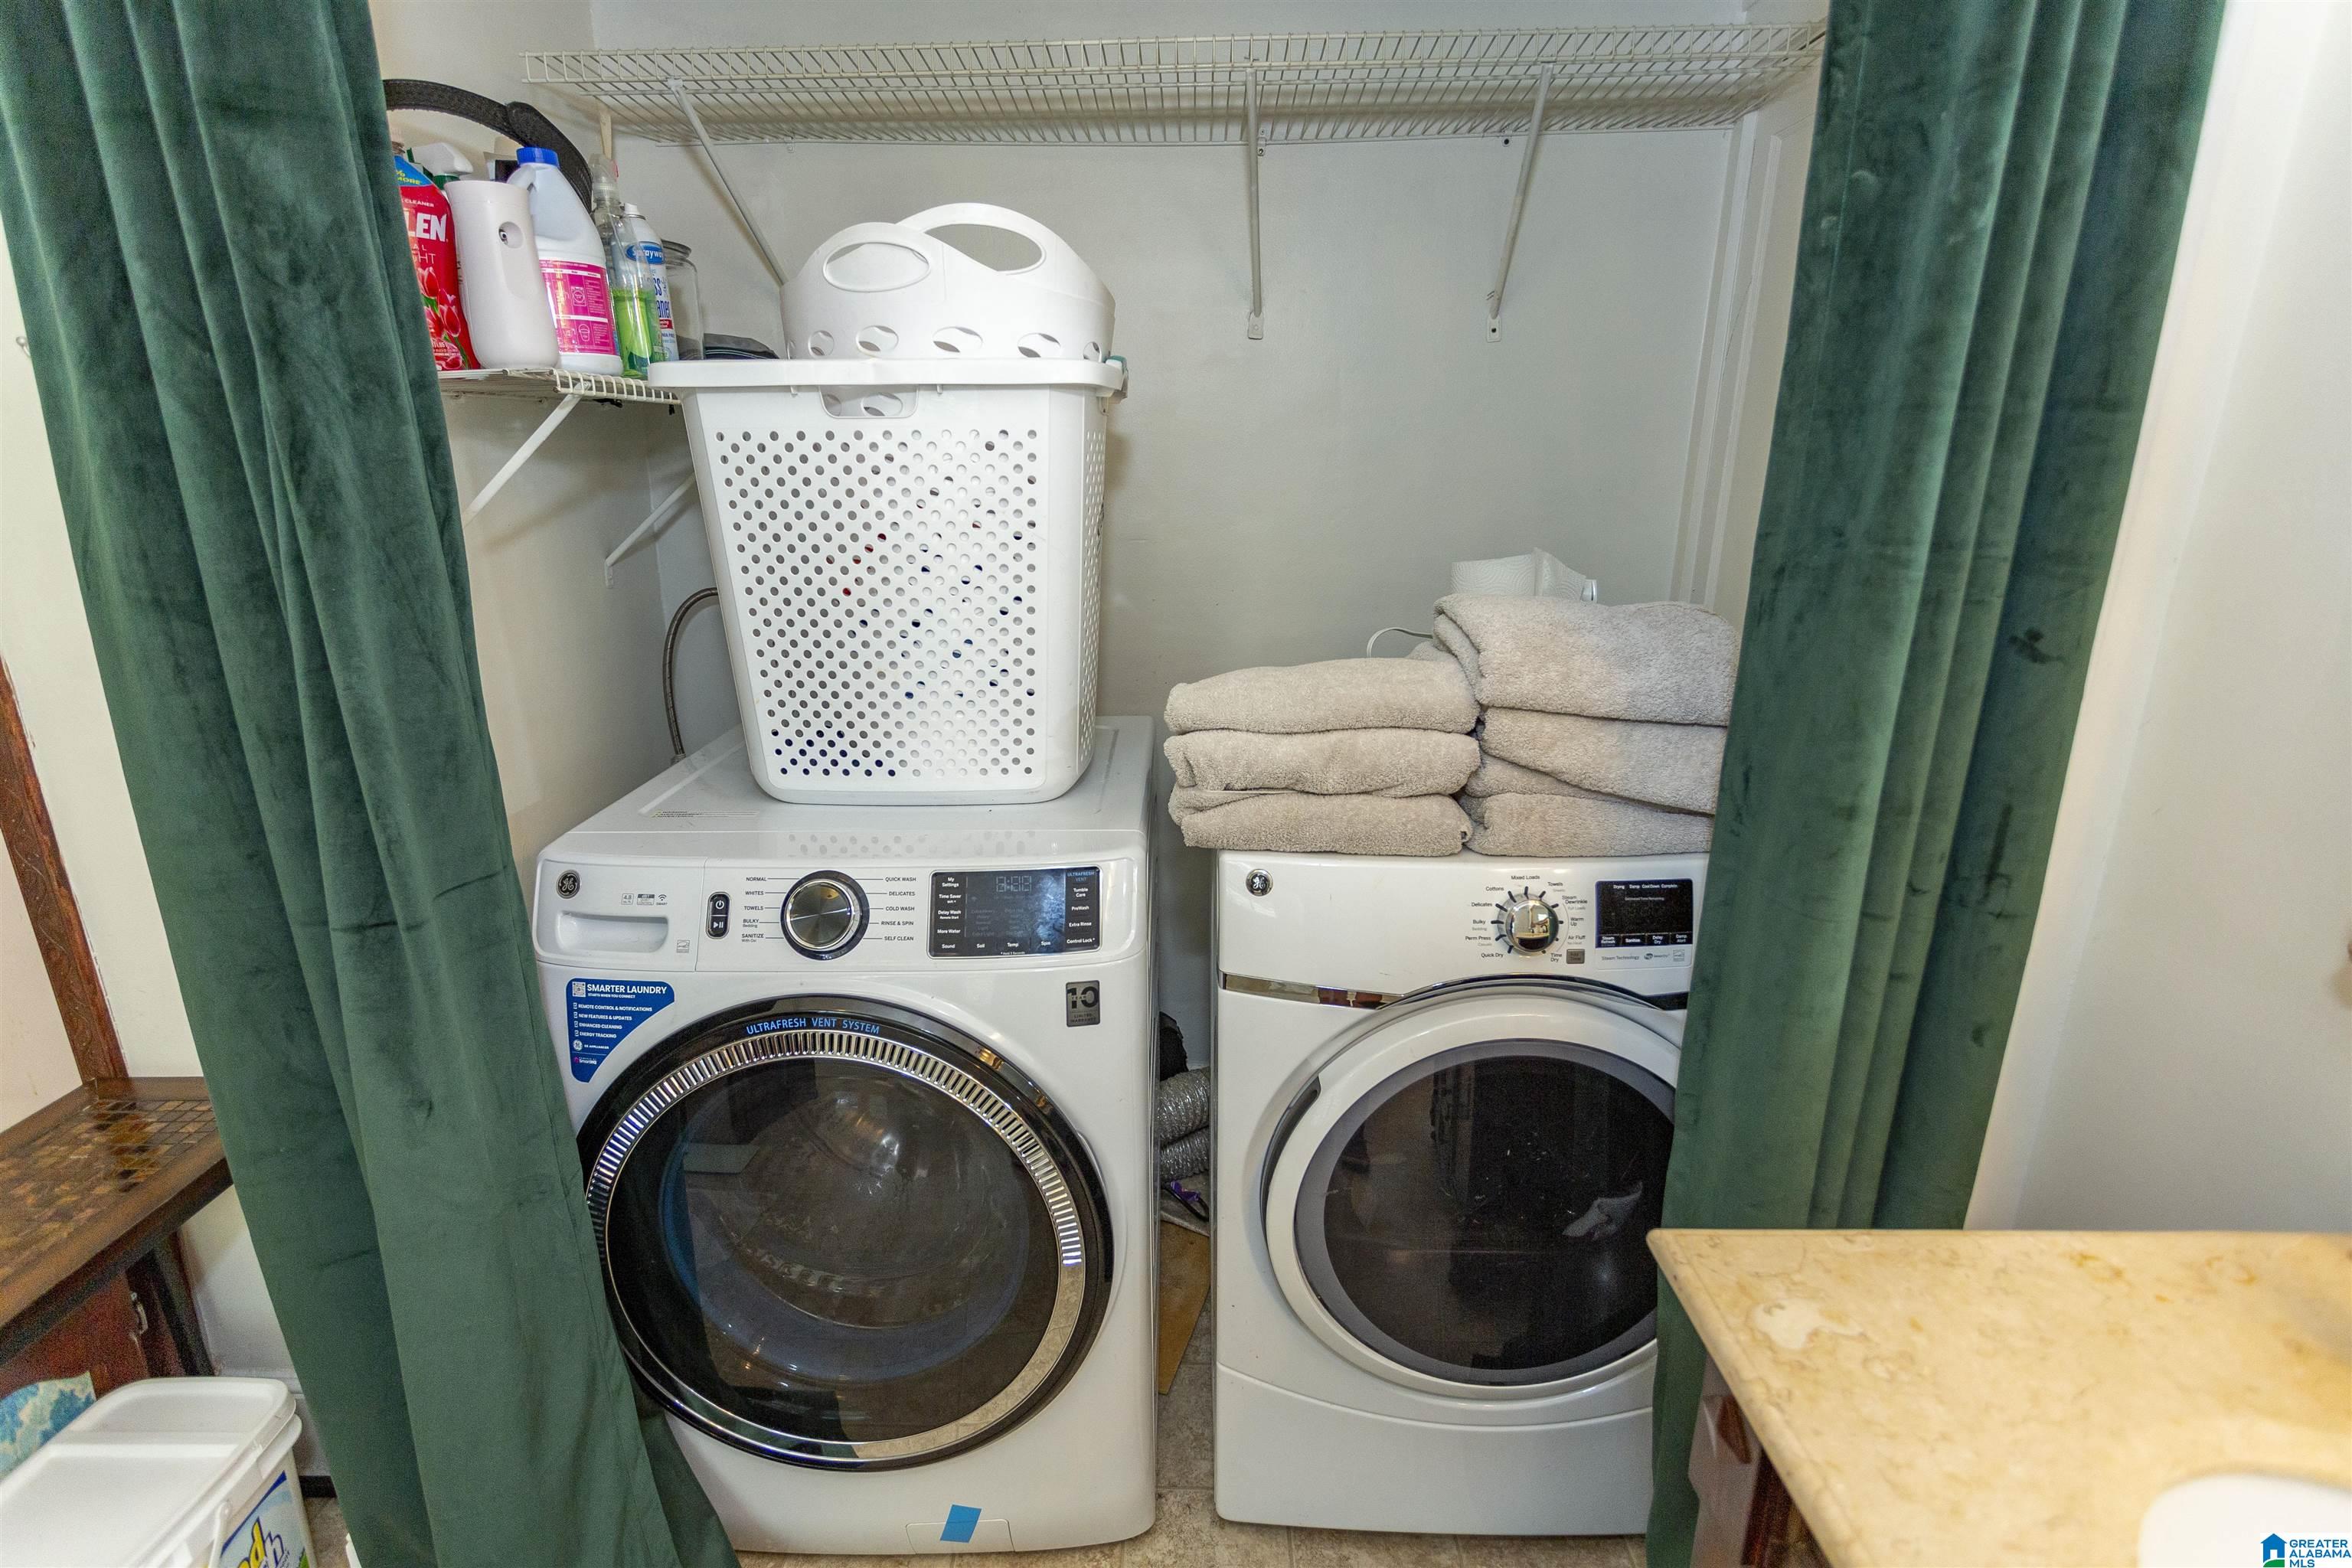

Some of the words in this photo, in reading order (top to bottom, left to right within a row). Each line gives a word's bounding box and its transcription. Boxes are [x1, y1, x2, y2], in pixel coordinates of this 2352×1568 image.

[404, 199, 434, 207] CLEANER
[586, 984, 626, 993] SMARTER
[627, 985, 667, 994] LAUNDRY
[1067, 986, 1099, 1008] 10
[746, 1018, 806, 1035] ULTRAFRESH
[812, 1018, 837, 1028] VENT
[842, 1020, 880, 1034] SYSTEM
